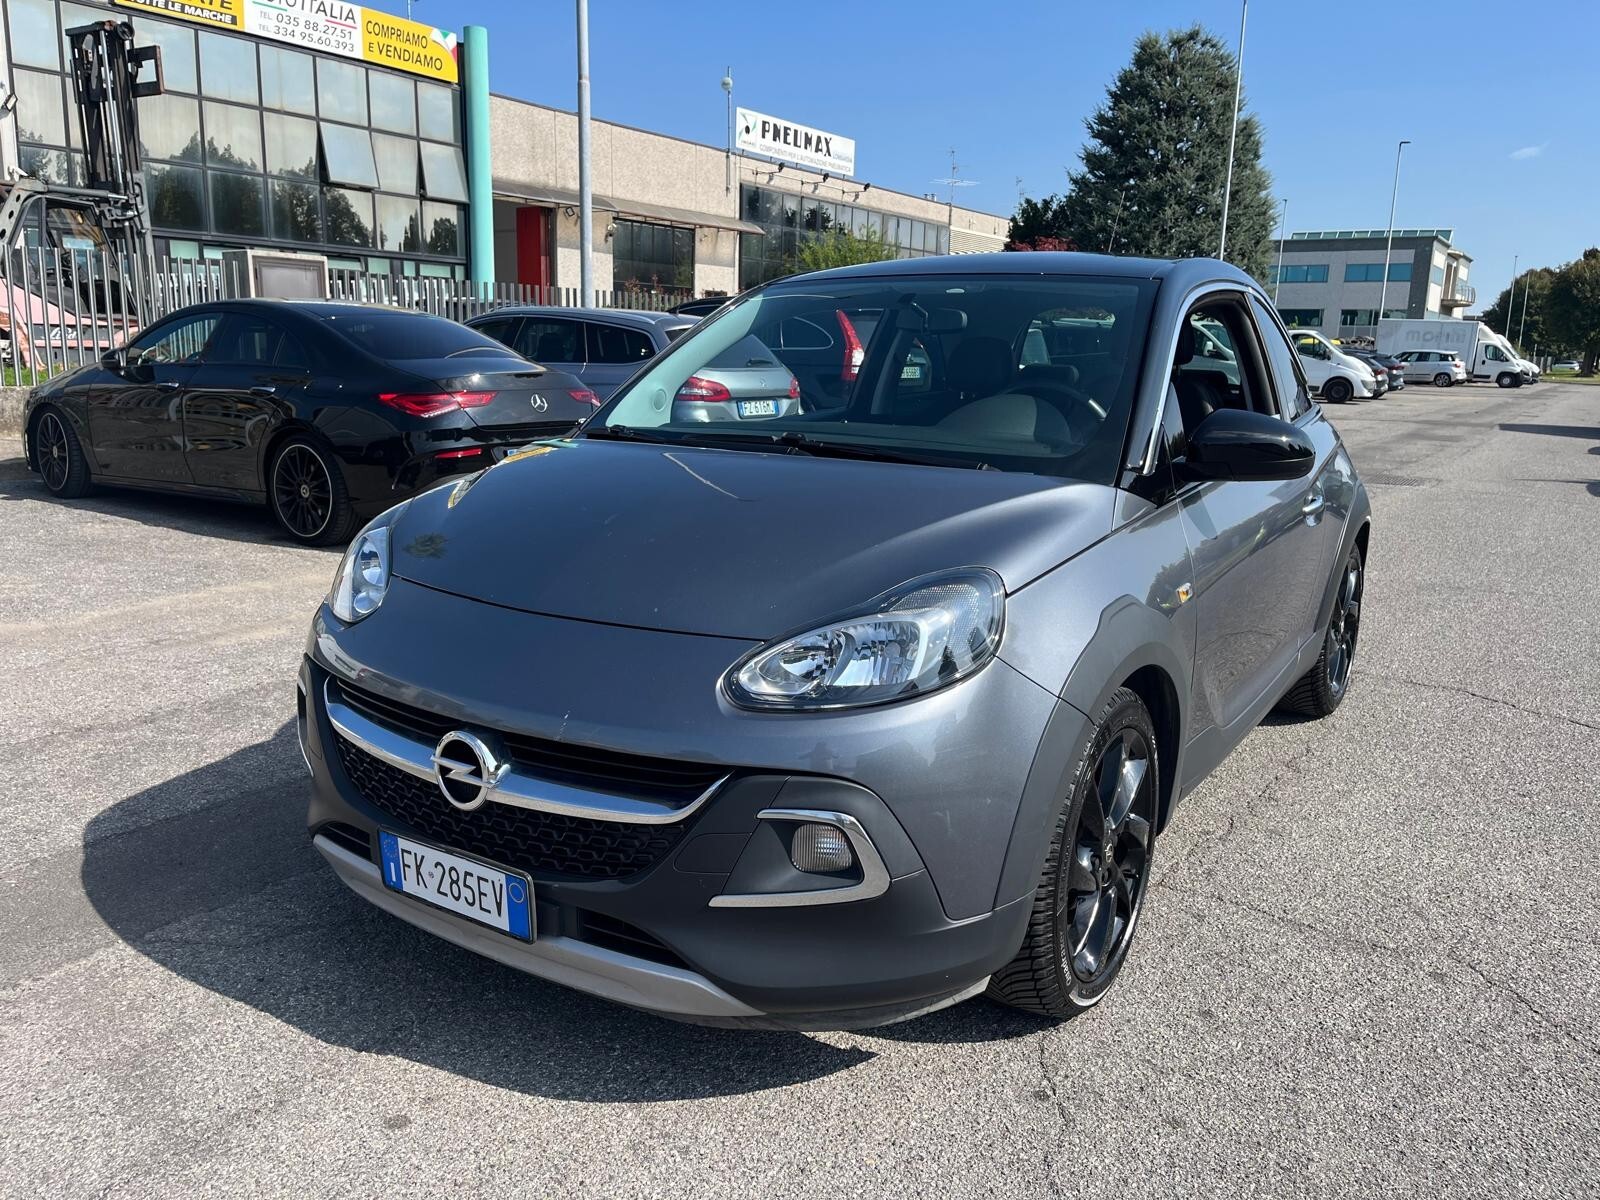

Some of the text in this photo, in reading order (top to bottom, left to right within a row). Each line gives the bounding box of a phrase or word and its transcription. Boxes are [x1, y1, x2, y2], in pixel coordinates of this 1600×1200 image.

[168, 1, 182, 12] LE
[184, 5, 232, 24] MARCHE
[276, 13, 300, 27] 035
[304, 20, 352, 40] 88.27.51
[273, 25, 295, 38] 334
[300, 31, 354, 52] 95.60.393
[366, 20, 428, 49] COMPRIAMO
[368, 42, 442, 71] E VENDIAMO
[761, 120, 832, 157] PNEUMAX
